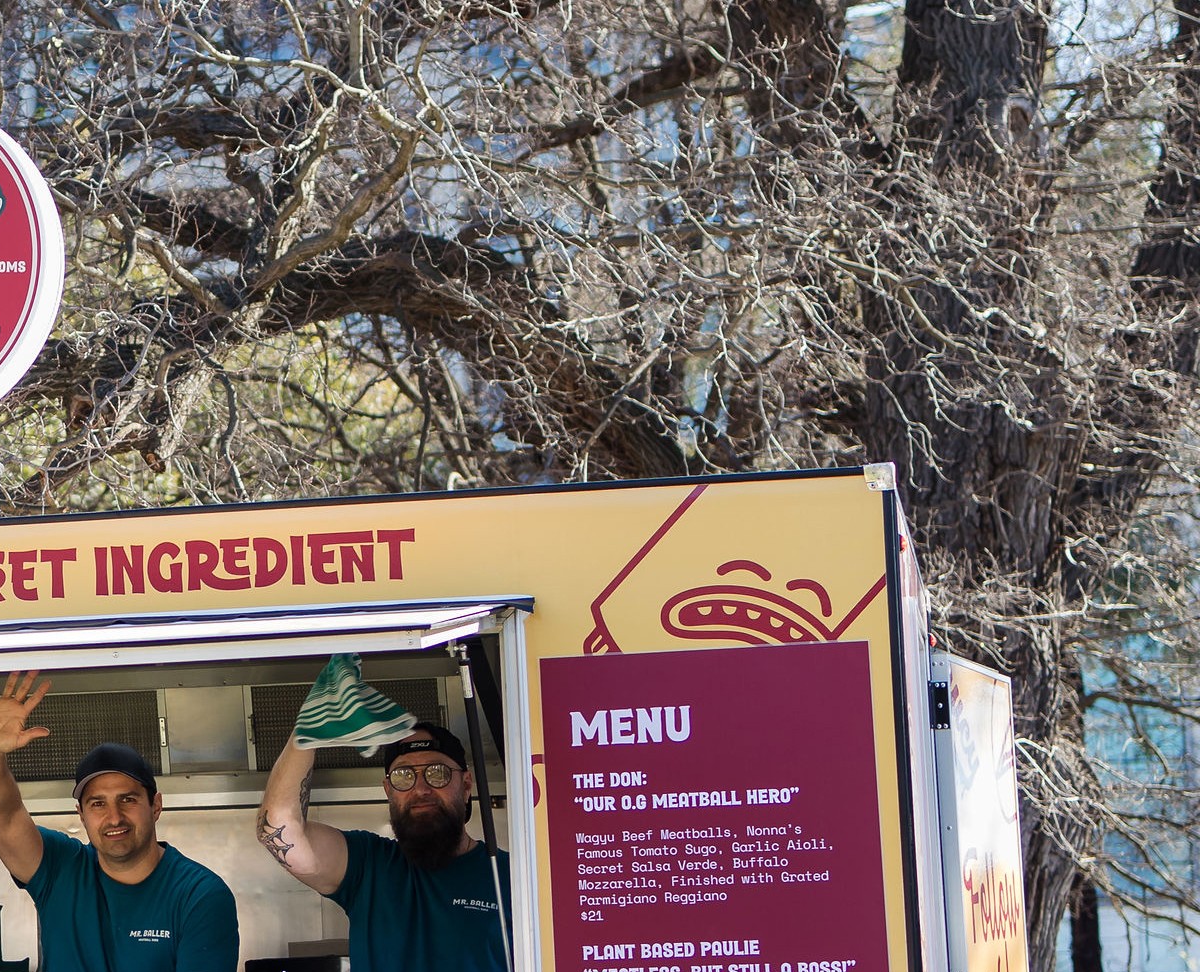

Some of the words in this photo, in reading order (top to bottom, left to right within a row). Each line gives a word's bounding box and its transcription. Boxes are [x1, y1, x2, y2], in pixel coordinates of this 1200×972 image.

[94, 528, 416, 597] INGREDIENT
[569, 705, 691, 747] MENU
[572, 773, 605, 789] THE
[609, 771, 647, 788] DON:
[621, 794, 647, 811] O.G
[652, 790, 742, 809] MEATBALL
[576, 832, 615, 846] Wagyu
[622, 829, 653, 842] Beef
[660, 827, 738, 841] Meatballs,
[746, 824, 802, 837] Nonna’s
[577, 847, 623, 860] Famous
[631, 845, 678, 858] Tomato
[685, 844, 723, 858] Sugo,
[731, 840, 780, 853] Garlic
[787, 838, 834, 851] Aioli,
[577, 862, 624, 875] Secret
[631, 861, 671, 874] Salsa
[678, 858, 724, 872] Verde,
[733, 856, 788, 869] Buffalo
[578, 877, 662, 892] Mozzarella,
[671, 874, 734, 888] Finished
[741, 872, 774, 885] with
[780, 870, 830, 884] Grated
[452, 898, 469, 906] MR.
[579, 893, 657, 908] Parmigiano
[664, 891, 728, 905] Reggiano
[962, 847, 1020, 944] Follow
[580, 910, 604, 922] $21
[142, 929, 171, 939] BALLER
[582, 943, 636, 961] PLANT
[640, 942, 695, 960] BASED
[700, 939, 760, 957] PAULIE
